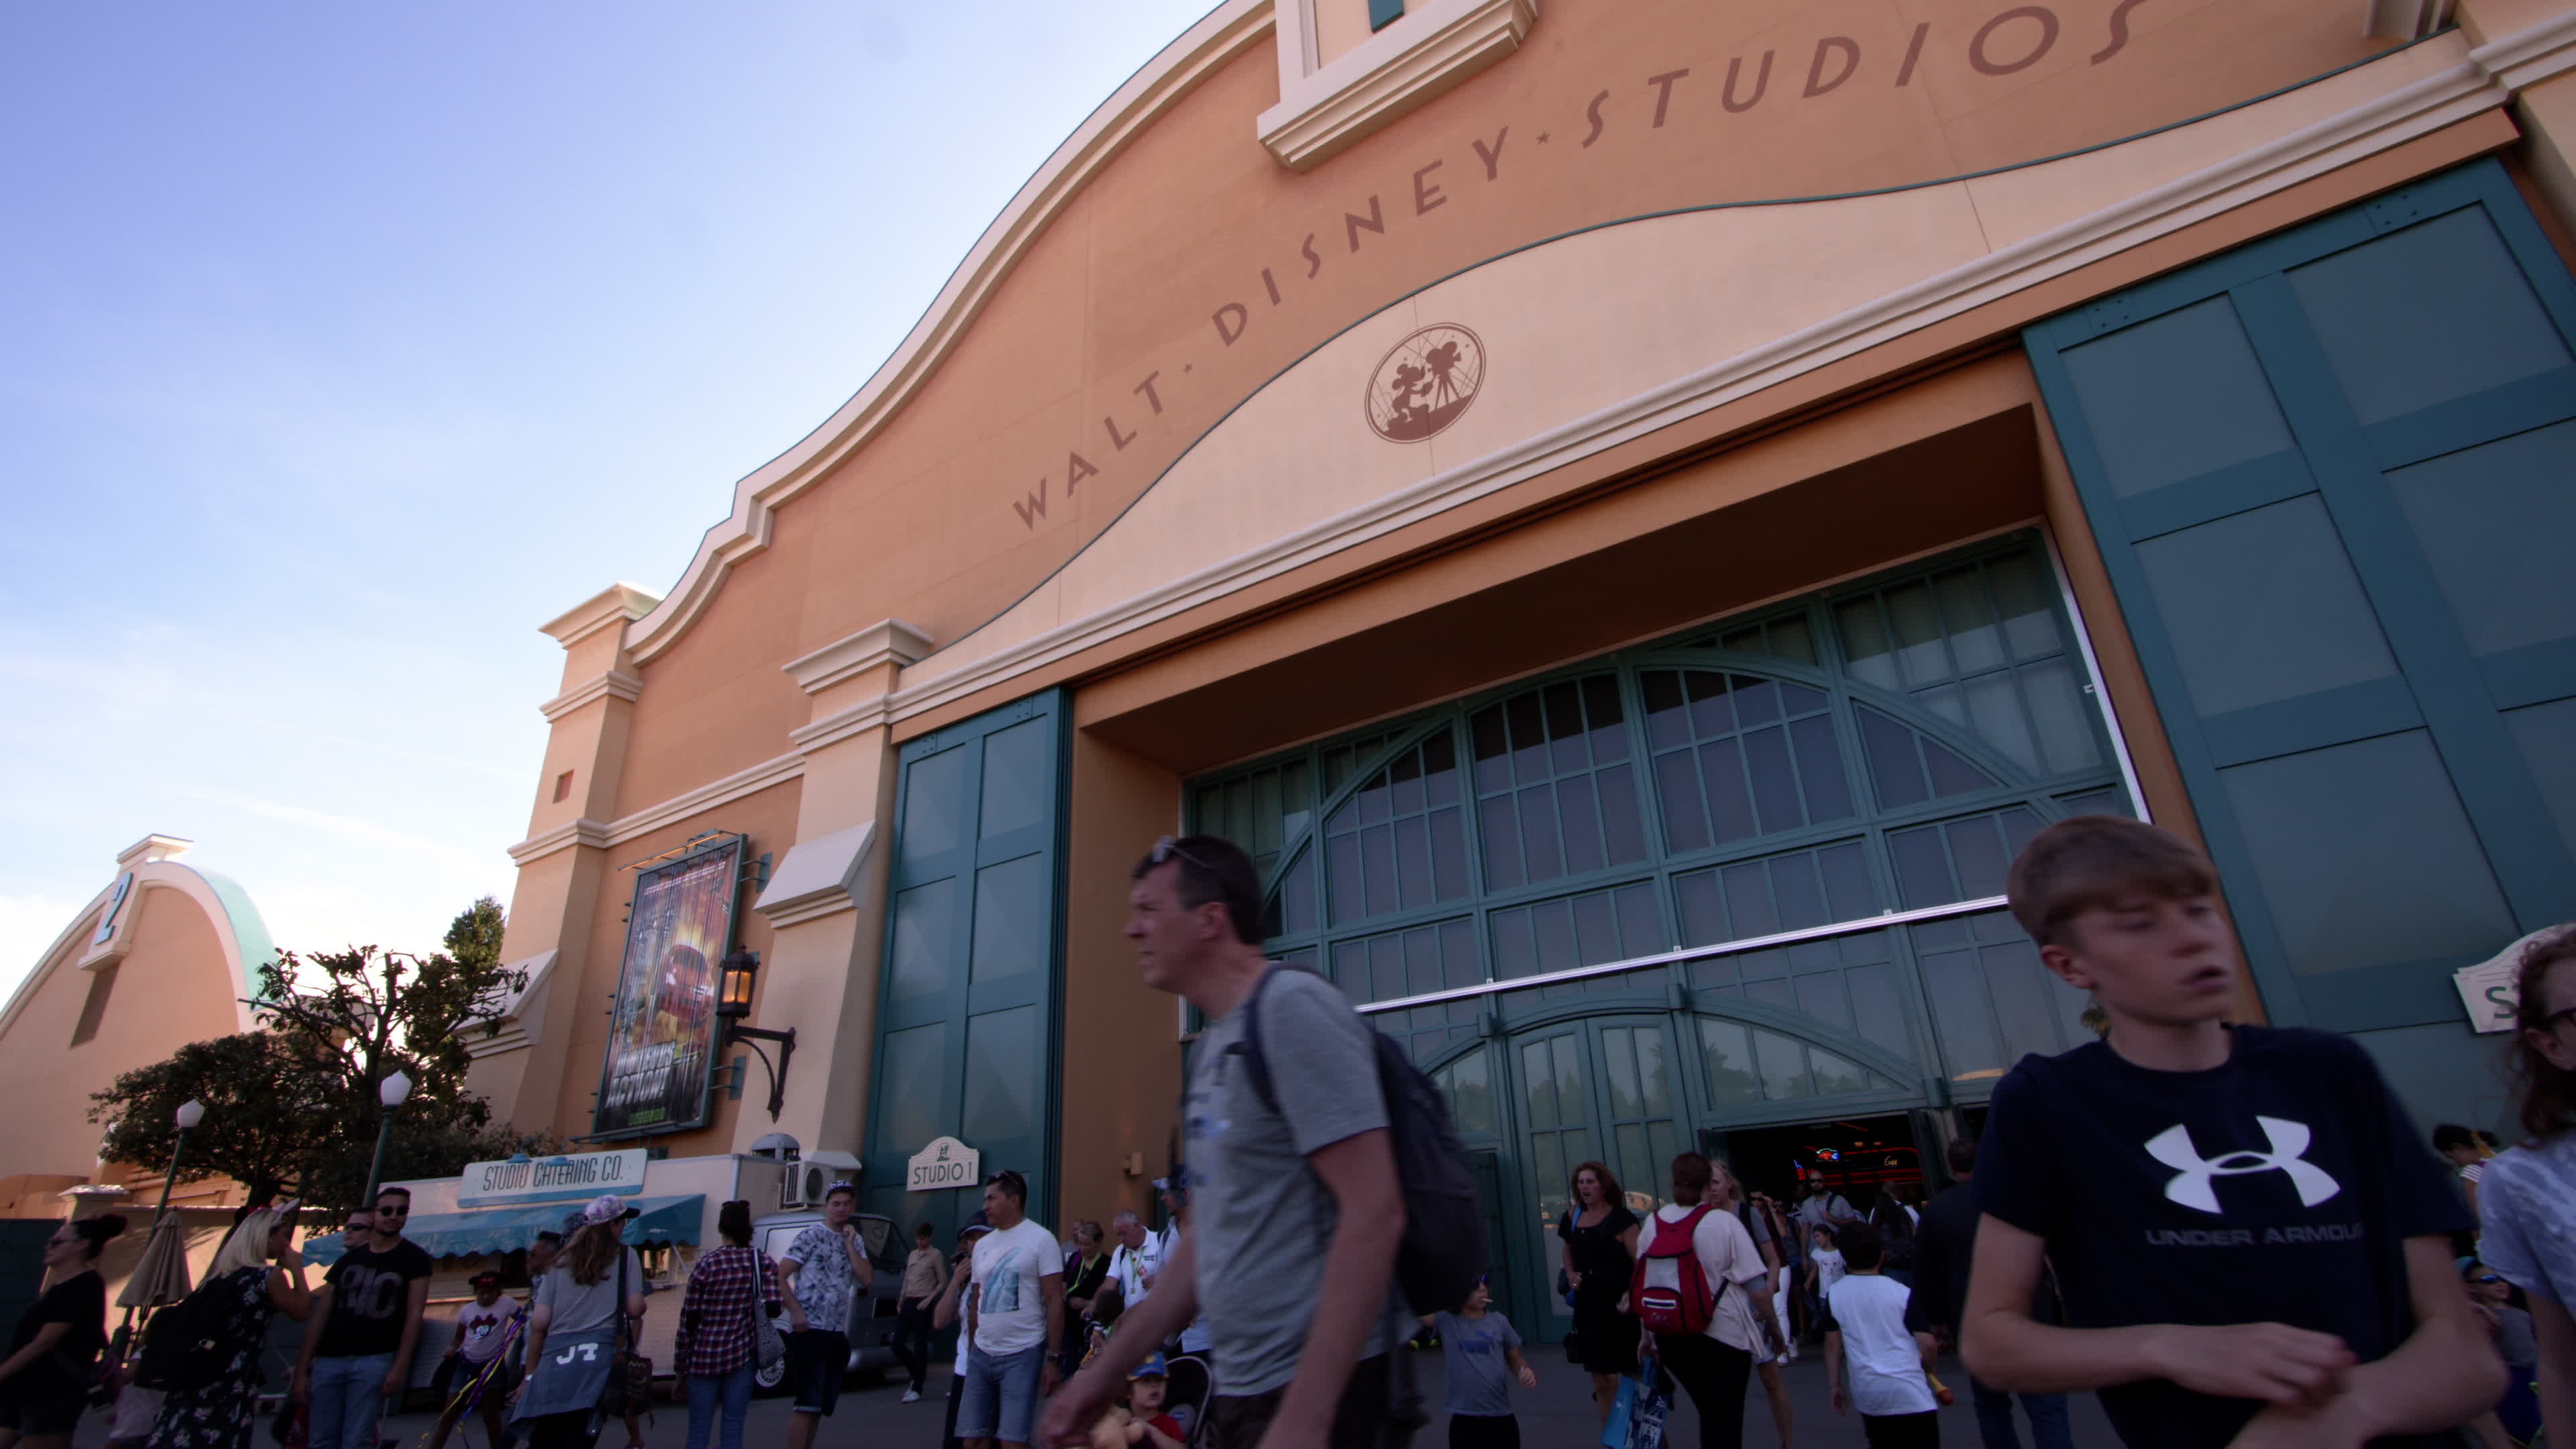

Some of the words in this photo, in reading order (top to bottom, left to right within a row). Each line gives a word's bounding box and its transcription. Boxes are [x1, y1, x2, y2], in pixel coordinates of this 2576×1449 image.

[1013, 370, 1163, 531] WALT
[1212, 126, 1508, 347] DISNEY
[1582, 0, 2147, 149] STUDIOS
[95, 872, 133, 945] 2
[483, 1163, 530, 1191] STUDIO
[533, 1157, 596, 1187] CATERING
[602, 1155, 623, 1181] CO.
[914, 1163, 963, 1185] STUDIO
[2145, 1229, 2254, 1246] UNDER
